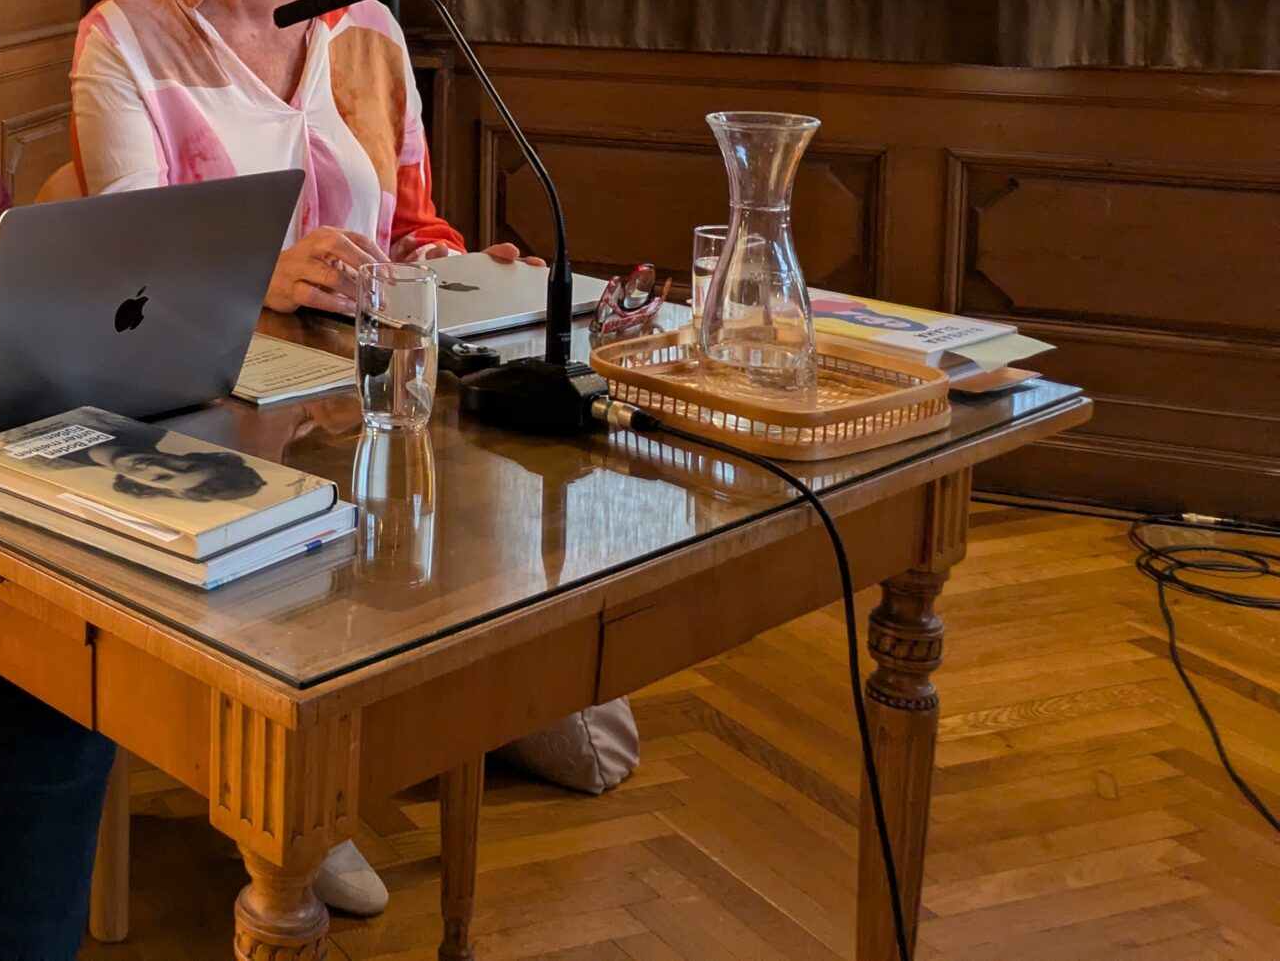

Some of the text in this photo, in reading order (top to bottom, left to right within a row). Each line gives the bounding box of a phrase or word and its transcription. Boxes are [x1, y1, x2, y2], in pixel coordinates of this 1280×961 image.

[42, 424, 85, 440] Füßen
[62, 429, 97, 443] unter
[86, 434, 111, 444] Der
[14, 440, 62, 457] meinen
[44, 441, 89, 456] Boden
